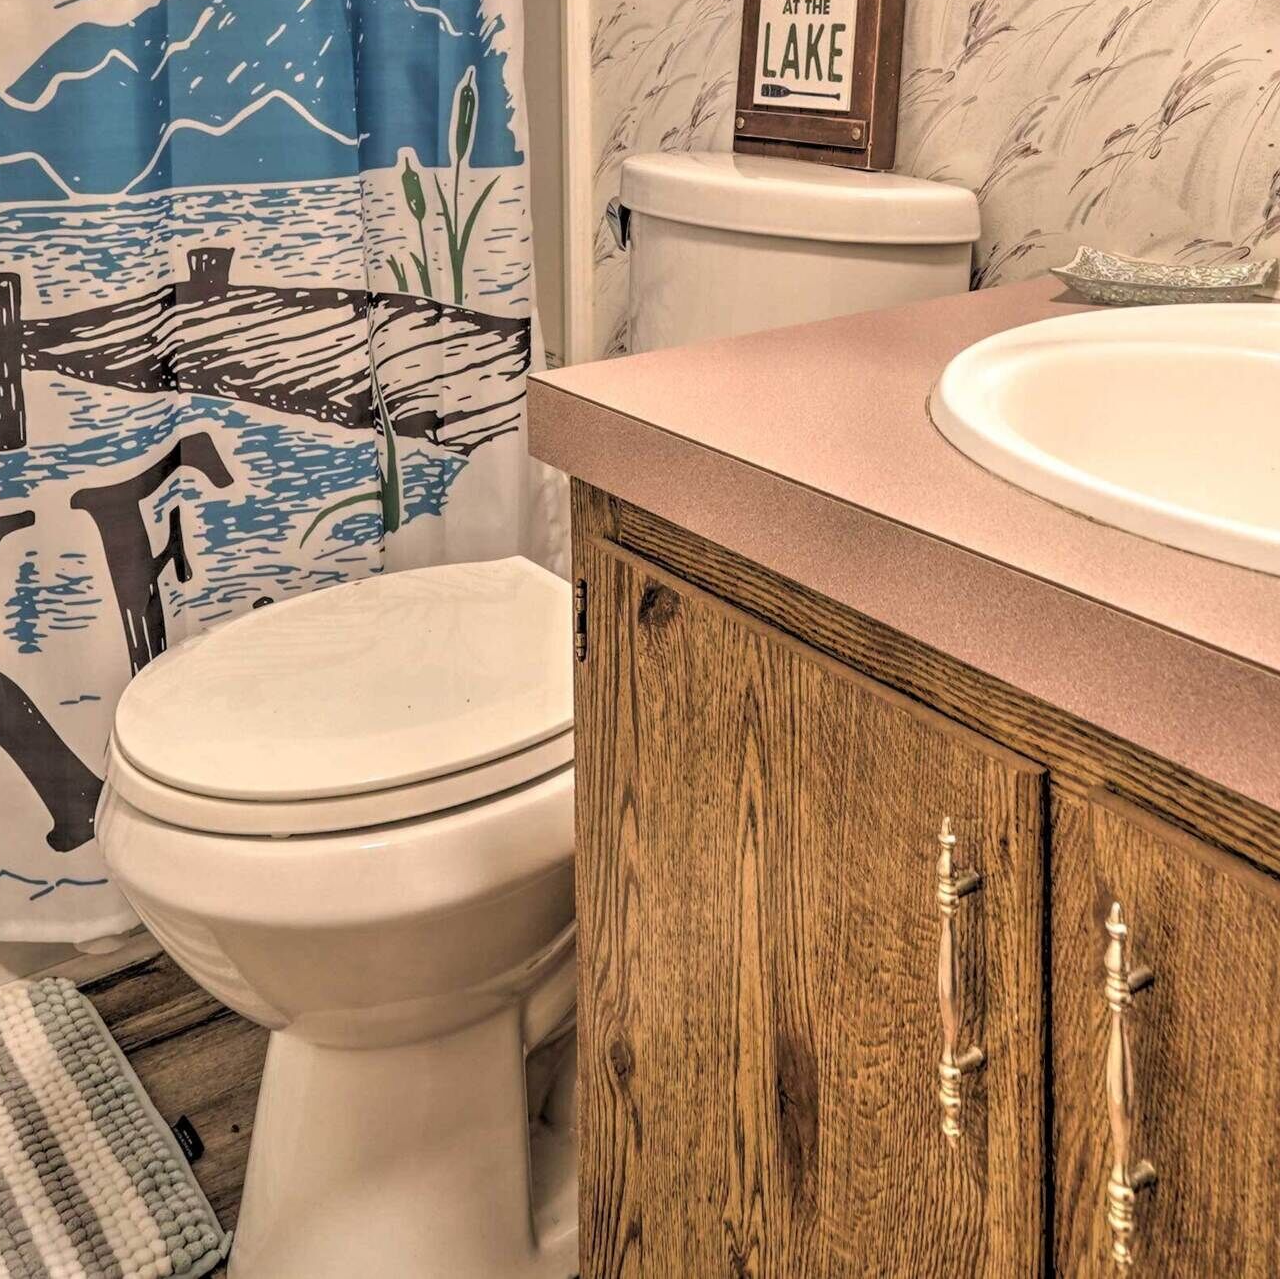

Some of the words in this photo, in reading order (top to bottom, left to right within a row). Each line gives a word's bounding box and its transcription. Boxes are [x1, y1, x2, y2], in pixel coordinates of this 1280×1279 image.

[782, 0, 800, 15] AT
[805, 0, 831, 15] THE
[763, 22, 846, 82] LAKE
